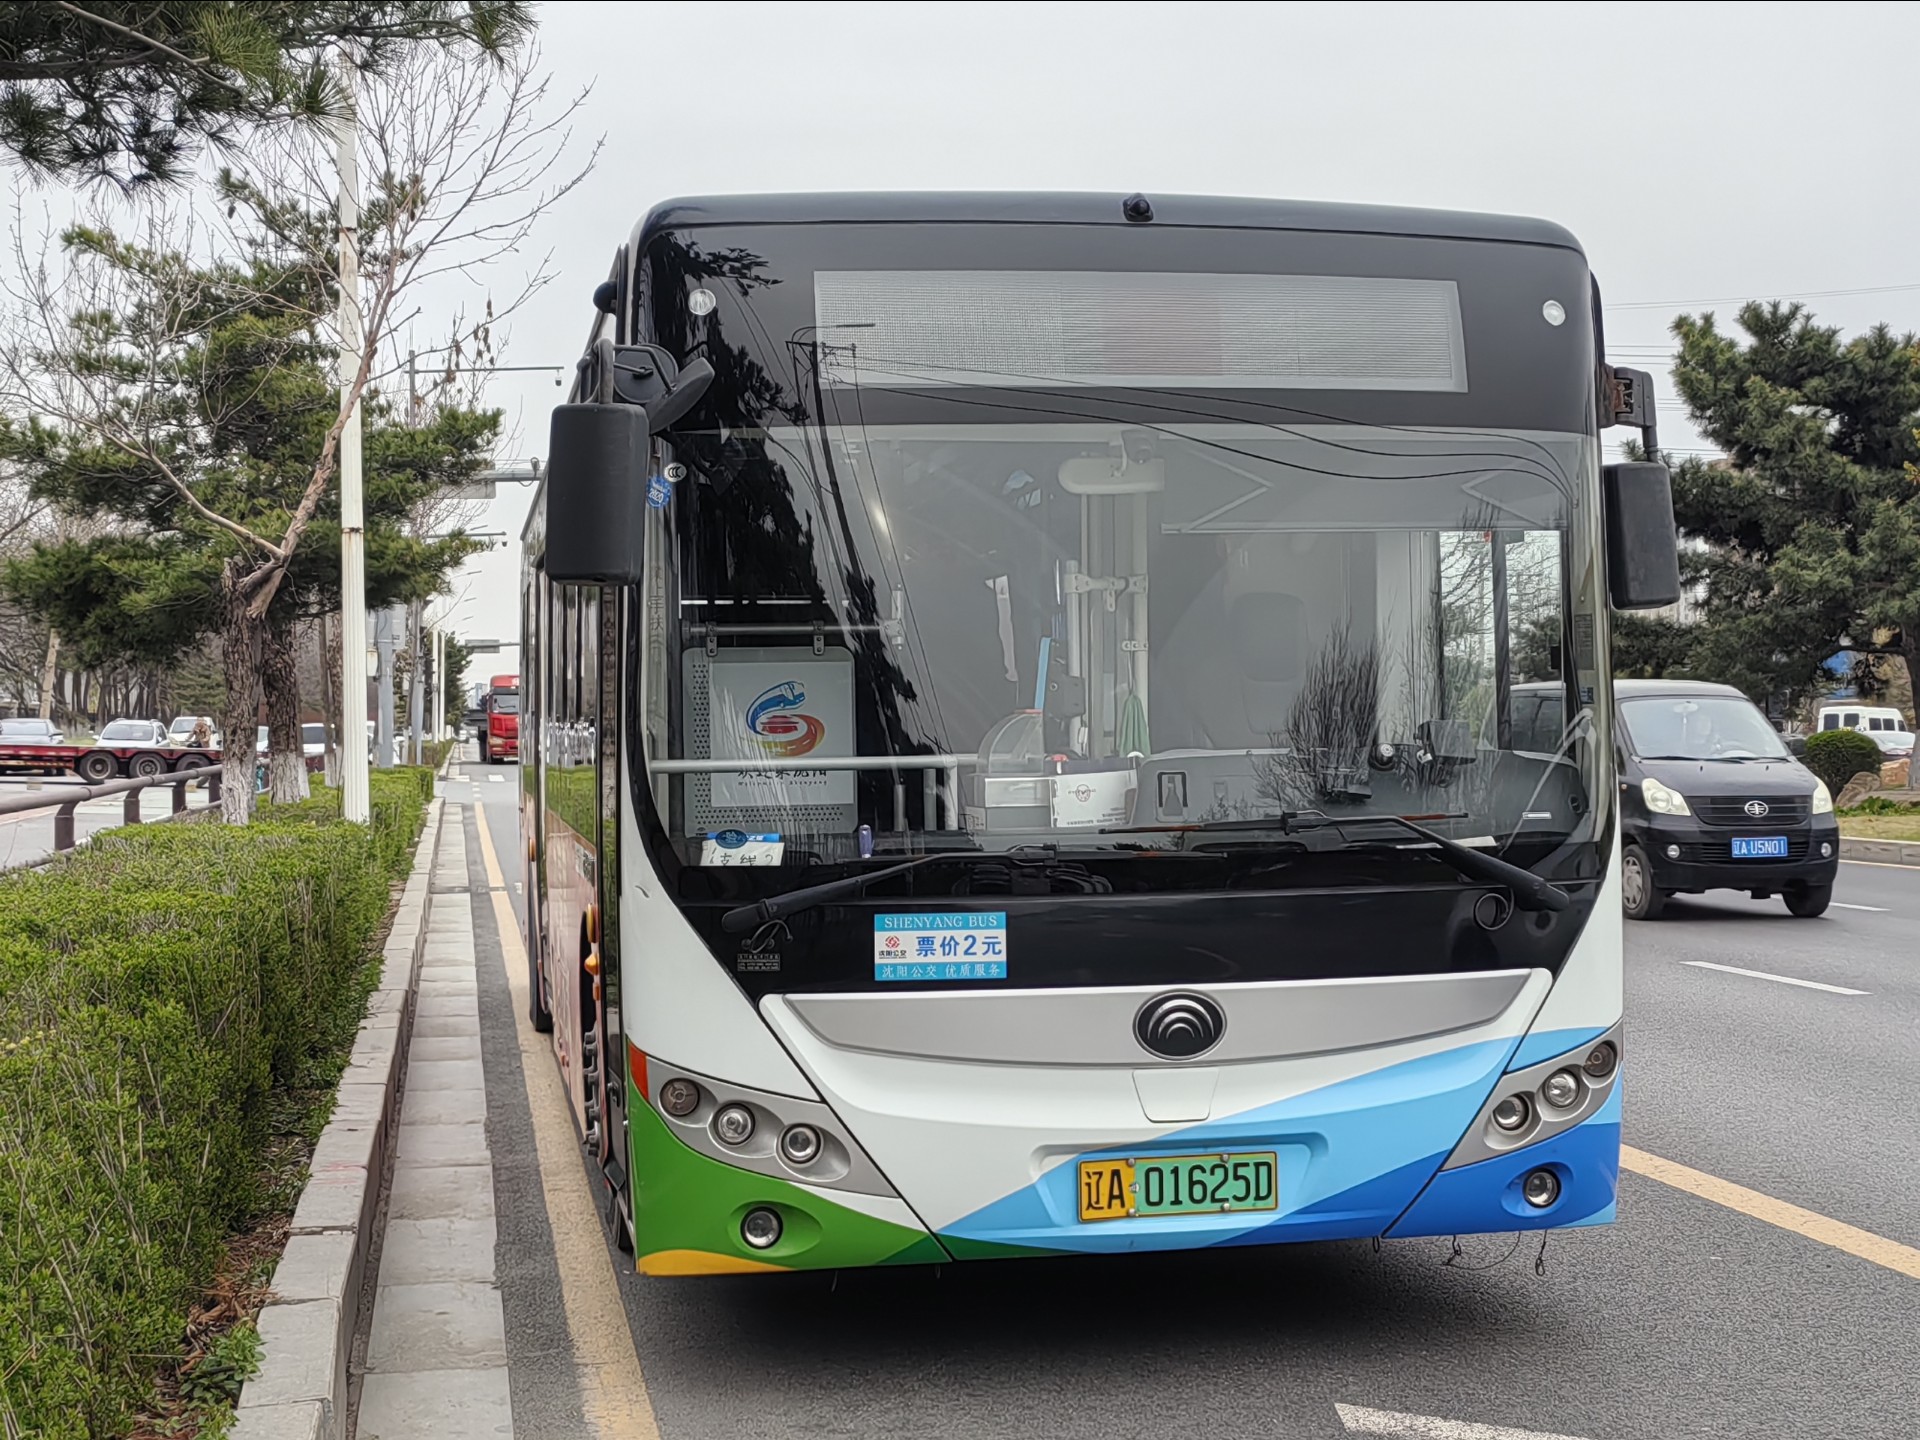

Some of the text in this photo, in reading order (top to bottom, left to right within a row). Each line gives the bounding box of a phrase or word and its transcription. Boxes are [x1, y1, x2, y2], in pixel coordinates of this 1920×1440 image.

[884, 915, 998, 929] SHENYANG BUS
[915, 934, 1002, 957] 票价2元
[882, 963, 1000, 978] 沈阳公交 优质服务
